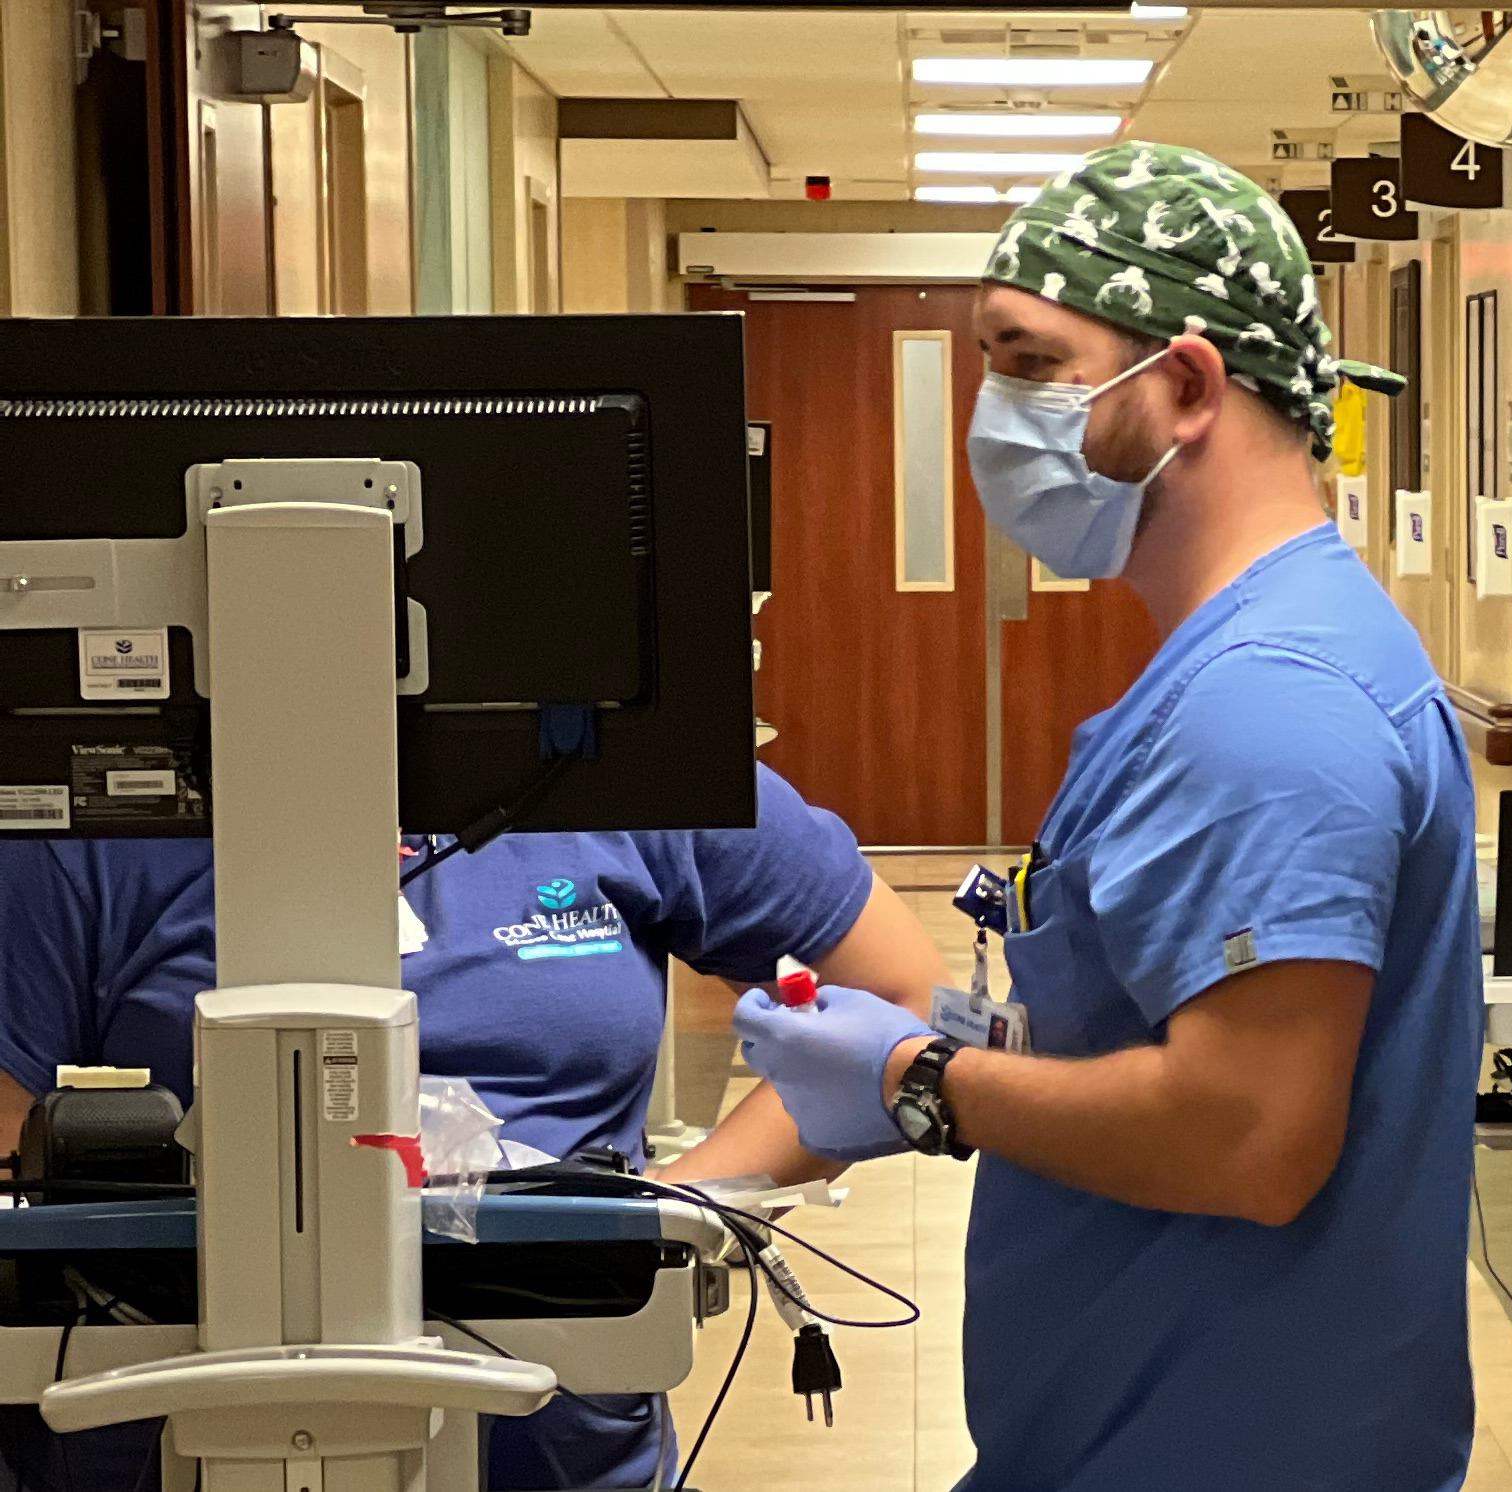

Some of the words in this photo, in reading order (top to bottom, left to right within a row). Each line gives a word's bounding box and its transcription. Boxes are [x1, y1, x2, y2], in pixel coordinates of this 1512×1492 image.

[1451, 139, 1481, 181] 4
[1371, 180, 1397, 218] 3
[1316, 209, 1335, 241] 2
